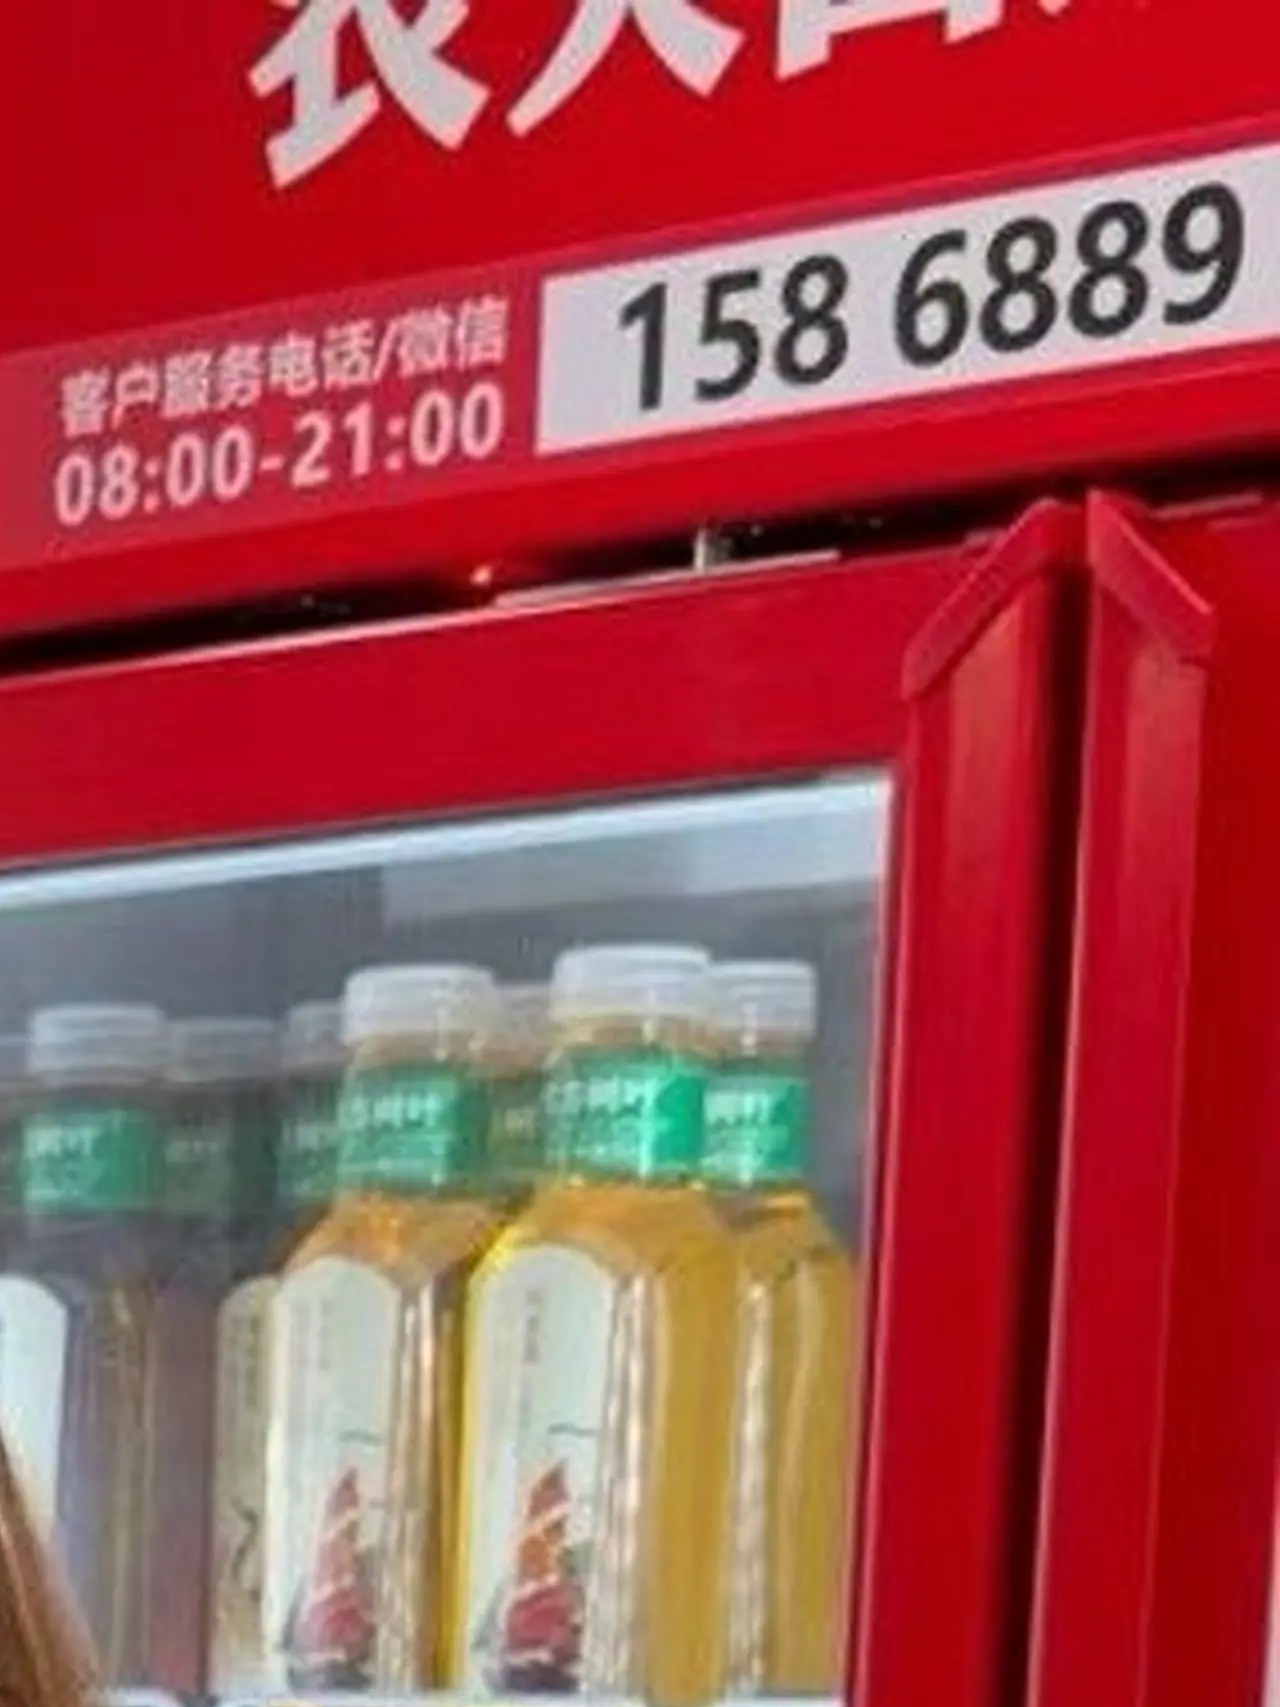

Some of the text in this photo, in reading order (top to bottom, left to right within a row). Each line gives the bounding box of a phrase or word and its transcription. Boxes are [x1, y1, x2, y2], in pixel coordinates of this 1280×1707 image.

[58, 295, 510, 439] 客户服务电话/微信
[618, 180, 1244, 411] 158 6889
[52, 380, 507, 527] 08:00-21:00
